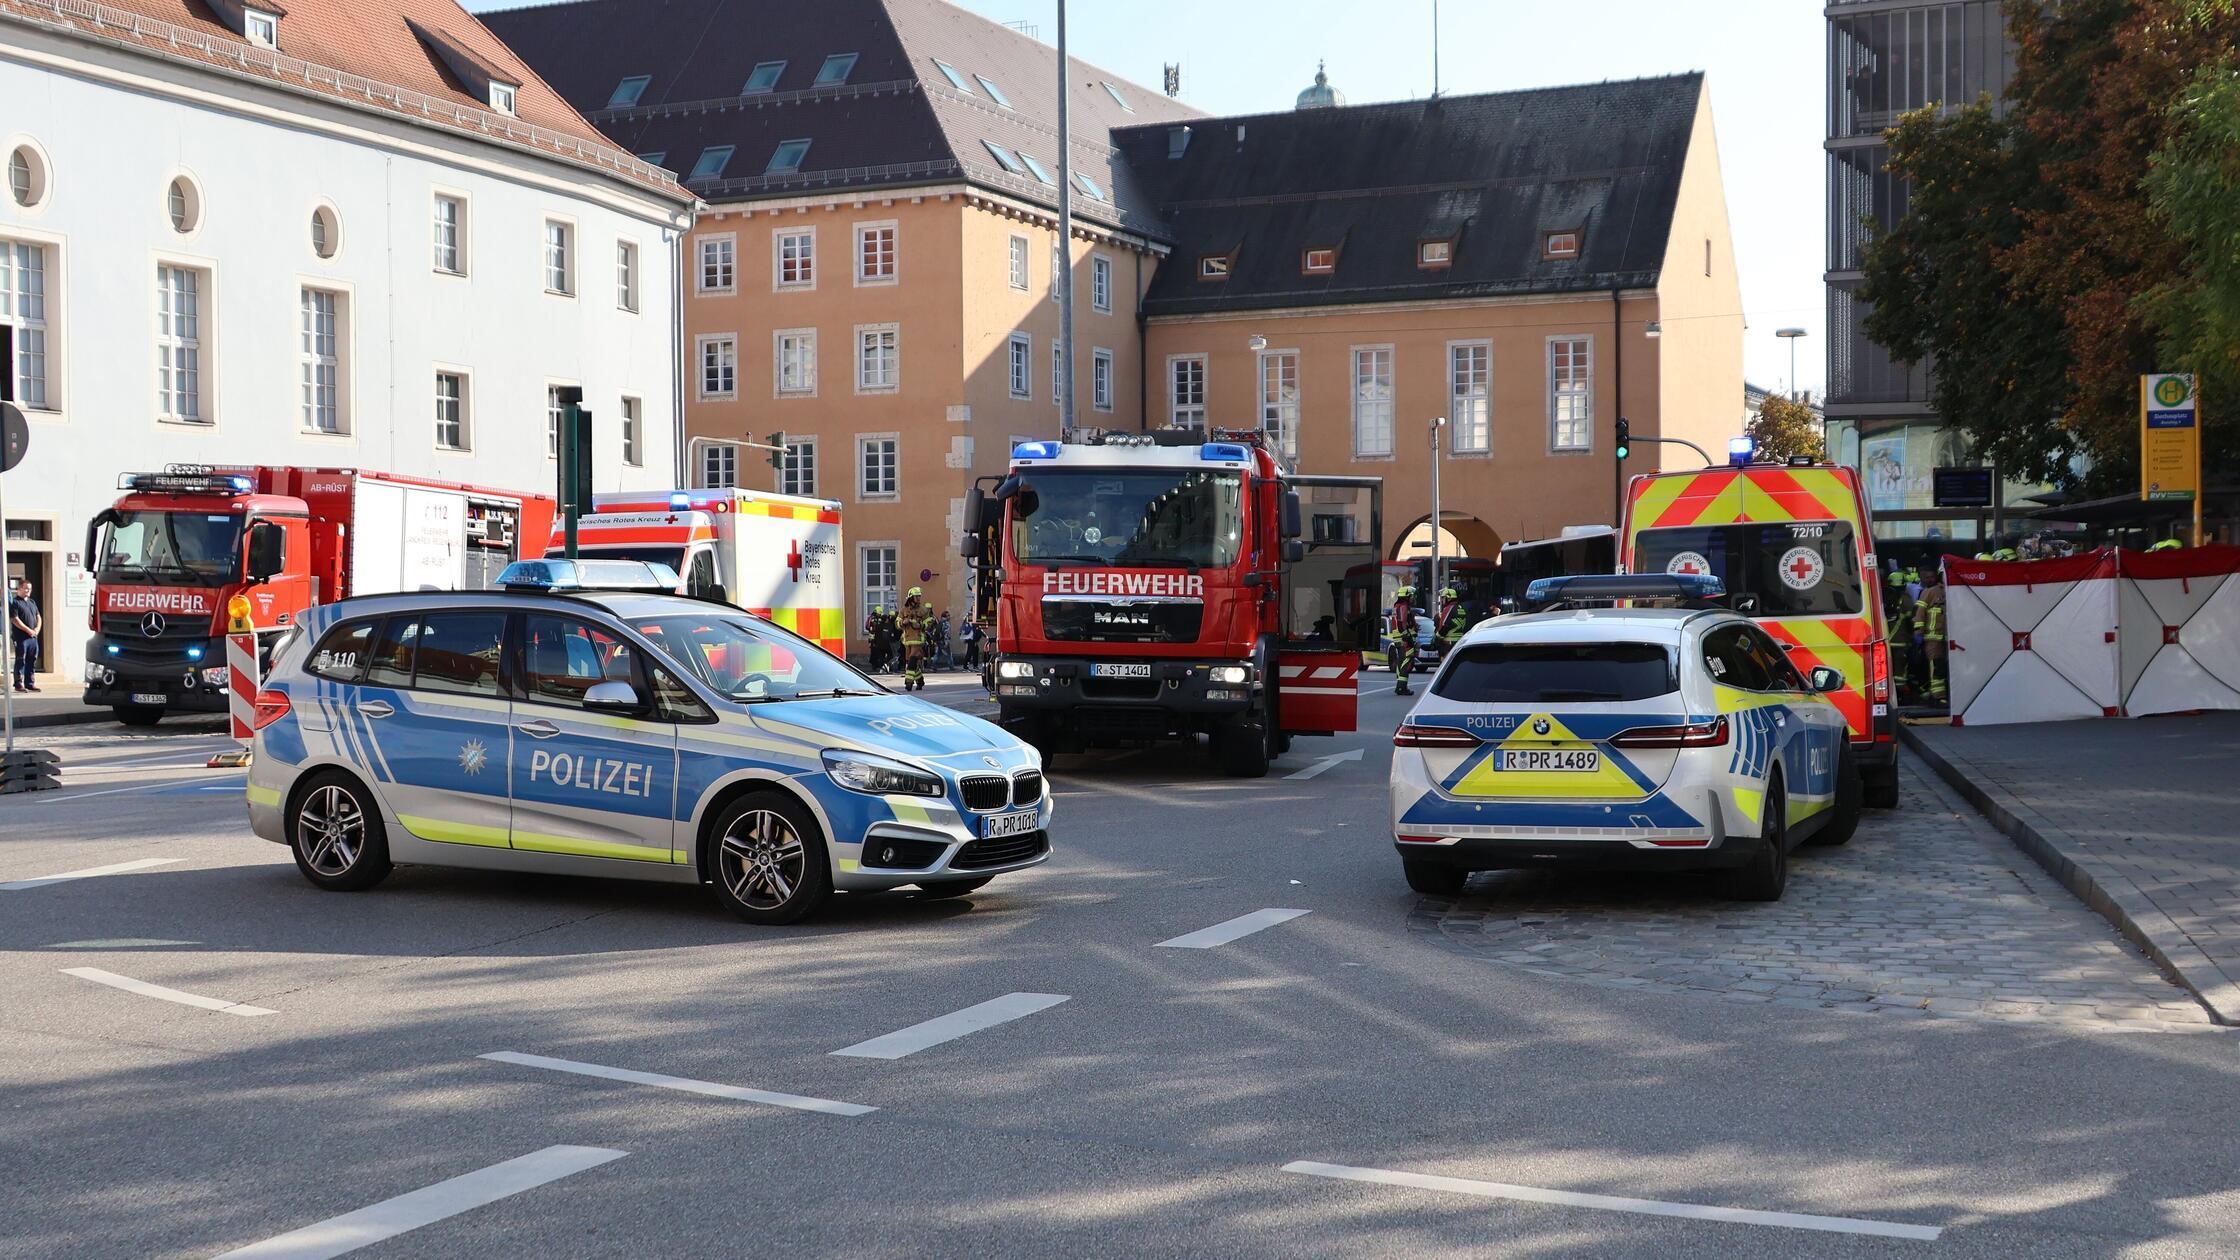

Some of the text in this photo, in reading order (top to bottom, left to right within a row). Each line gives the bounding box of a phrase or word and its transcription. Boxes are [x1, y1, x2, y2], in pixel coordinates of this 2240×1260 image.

[156, 476, 212, 486] FEUERWEHR
[310, 482, 347, 492] AB-RÜST
[433, 505, 448, 520] 112
[1792, 527, 1823, 538] 72/10
[804, 540, 836, 556] Bayerisches
[804, 555, 821, 569] Rotes
[1783, 549, 1820, 567] BAYERISCHES
[805, 571, 821, 584] Kreuz
[1042, 572, 1204, 596] FEUERWEHR
[1782, 569, 1822, 587] ROTES KREUZ
[108, 592, 204, 609] FEUERWEHR
[1094, 612, 1149, 624] MAN
[331, 652, 356, 668] 110
[1096, 664, 1150, 676] R ST 1401
[1466, 716, 1515, 729] POLIZEI
[1506, 752, 1517, 769] R
[1529, 752, 1551, 769] PR
[1554, 751, 1597, 769] 1489
[530, 749, 653, 798] POLIZEI
[989, 812, 1036, 836] R PR 1018
